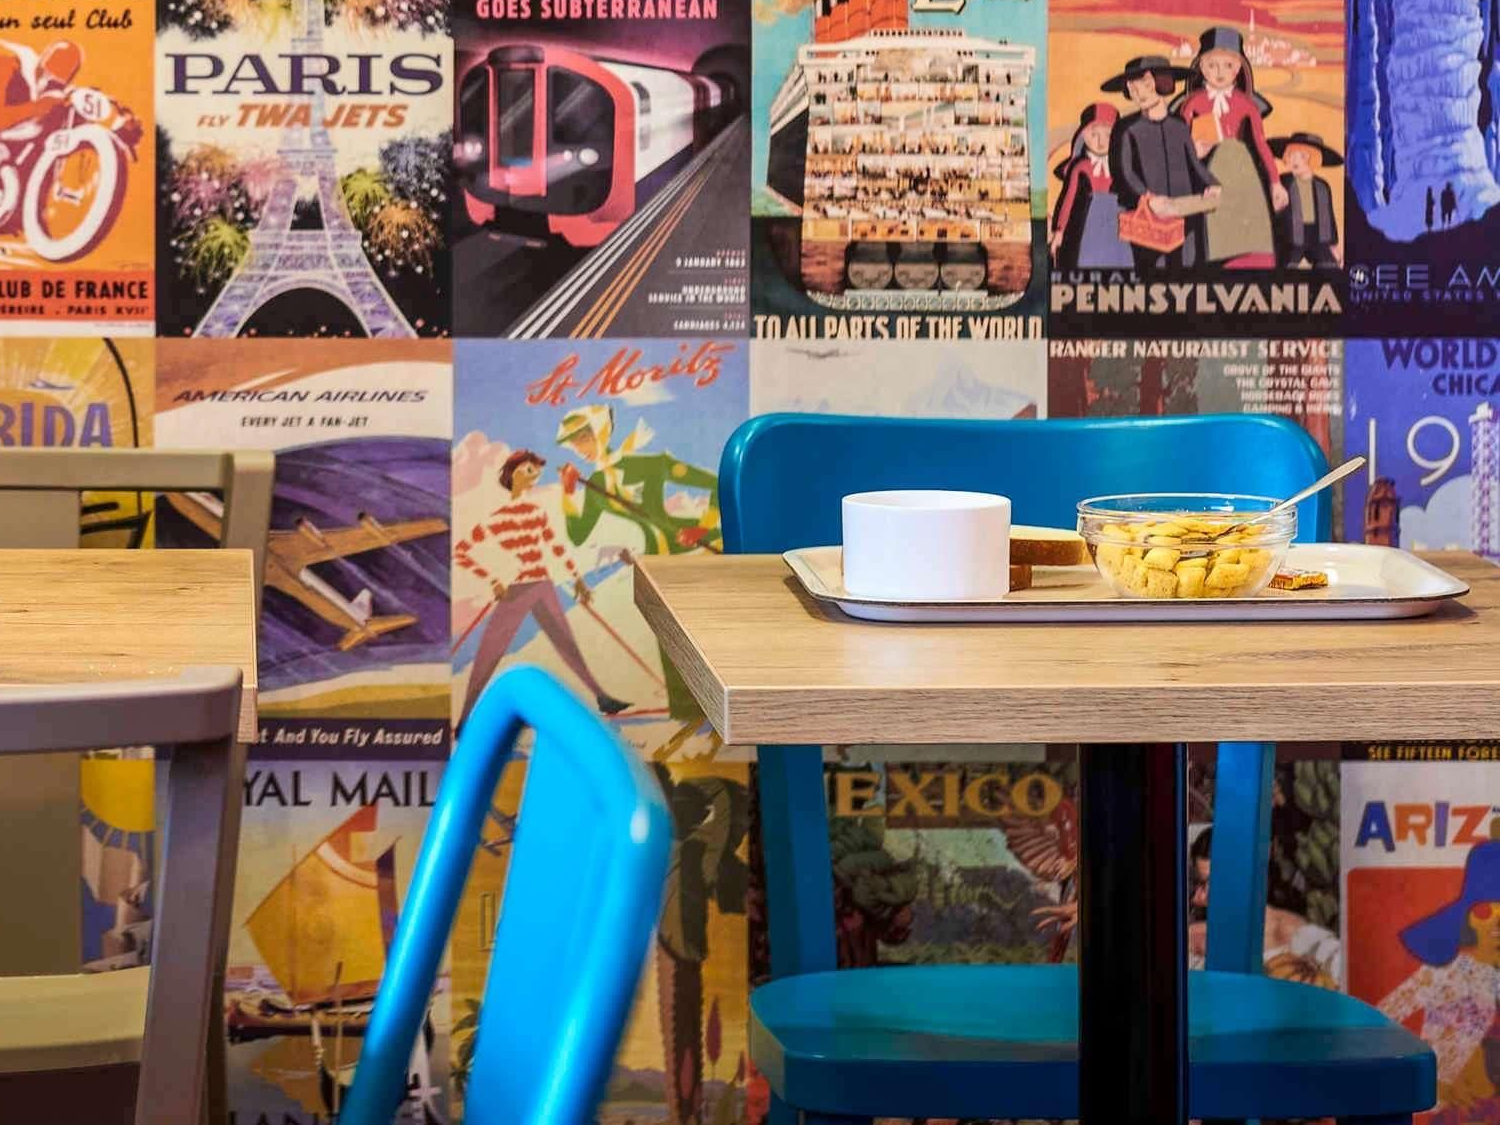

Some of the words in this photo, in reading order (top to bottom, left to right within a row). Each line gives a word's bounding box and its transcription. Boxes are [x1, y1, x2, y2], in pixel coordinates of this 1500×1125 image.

[31, 10, 78, 31] seul
[86, 8, 134, 31] Club
[164, 52, 445, 97] PARIS
[197, 113, 231, 127] FLY
[237, 104, 312, 129] TWA
[323, 104, 408, 129] JETS
[42, 279, 66, 299] DE
[74, 279, 149, 300] FRANCE
[1050, 282, 1343, 314] PENNSYLVANIA
[754, 315, 781, 340] TO
[823, 315, 891, 340] PARTS
[896, 315, 921, 340] OF
[925, 315, 963, 340] THE
[967, 315, 1044, 340] WORLD
[1050, 339, 1128, 359] RANGER
[1133, 339, 1248, 359] NATURALIST
[1257, 339, 1341, 359] SERVICE
[1380, 337, 1498, 370] WORLD
[577, 341, 738, 400] Moritz
[173, 390, 311, 403] AMERICAN
[314, 390, 429, 403] AIRLINES
[241, 416, 277, 428] EVERY
[282, 416, 303, 428] JET
[274, 727, 306, 744] And
[309, 727, 339, 744] You
[343, 728, 368, 747] Fly
[373, 727, 444, 745] Assured
[1396, 745, 1453, 762] FIFTEEN
[330, 770, 437, 807] MAIL
